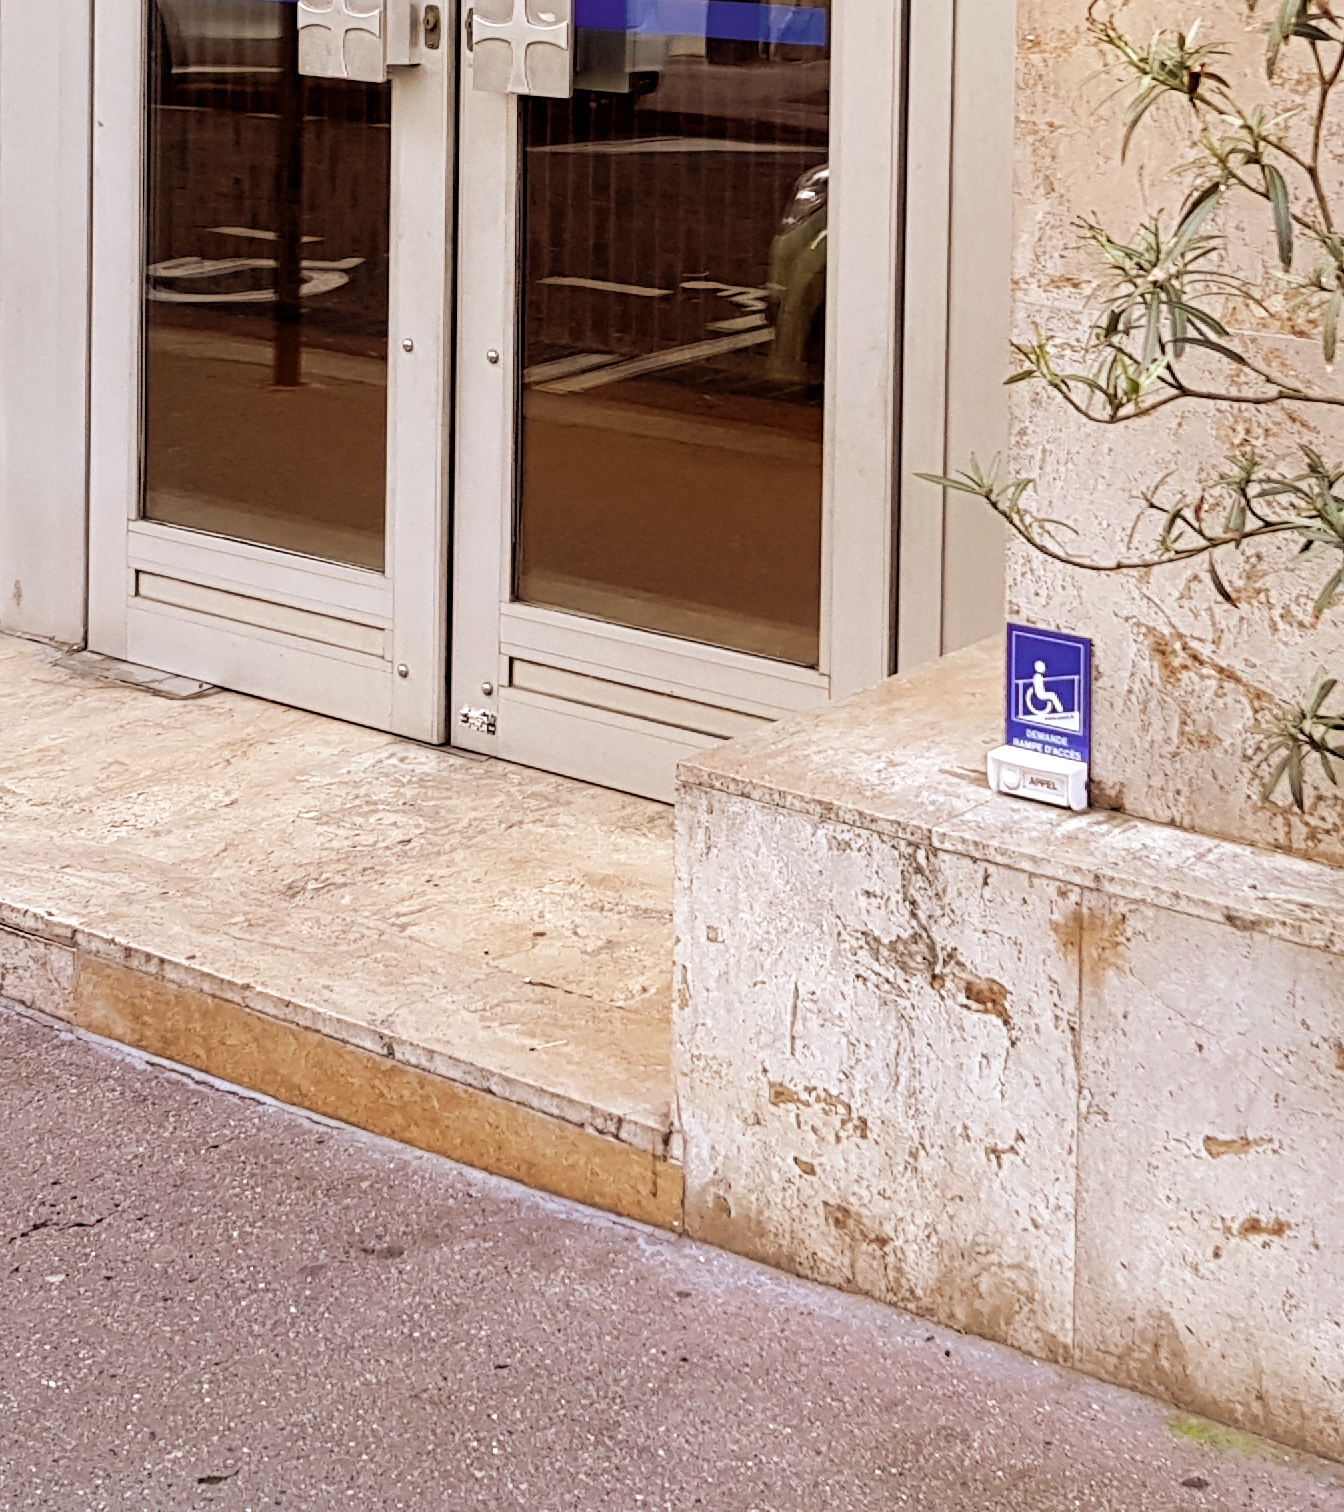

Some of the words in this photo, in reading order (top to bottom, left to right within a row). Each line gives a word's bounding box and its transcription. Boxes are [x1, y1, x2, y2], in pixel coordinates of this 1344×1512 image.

[1012, 737, 1043, 752] RAMPE
[1025, 728, 1068, 746] DEMANDE
[1029, 777, 1057, 790] APPEL
